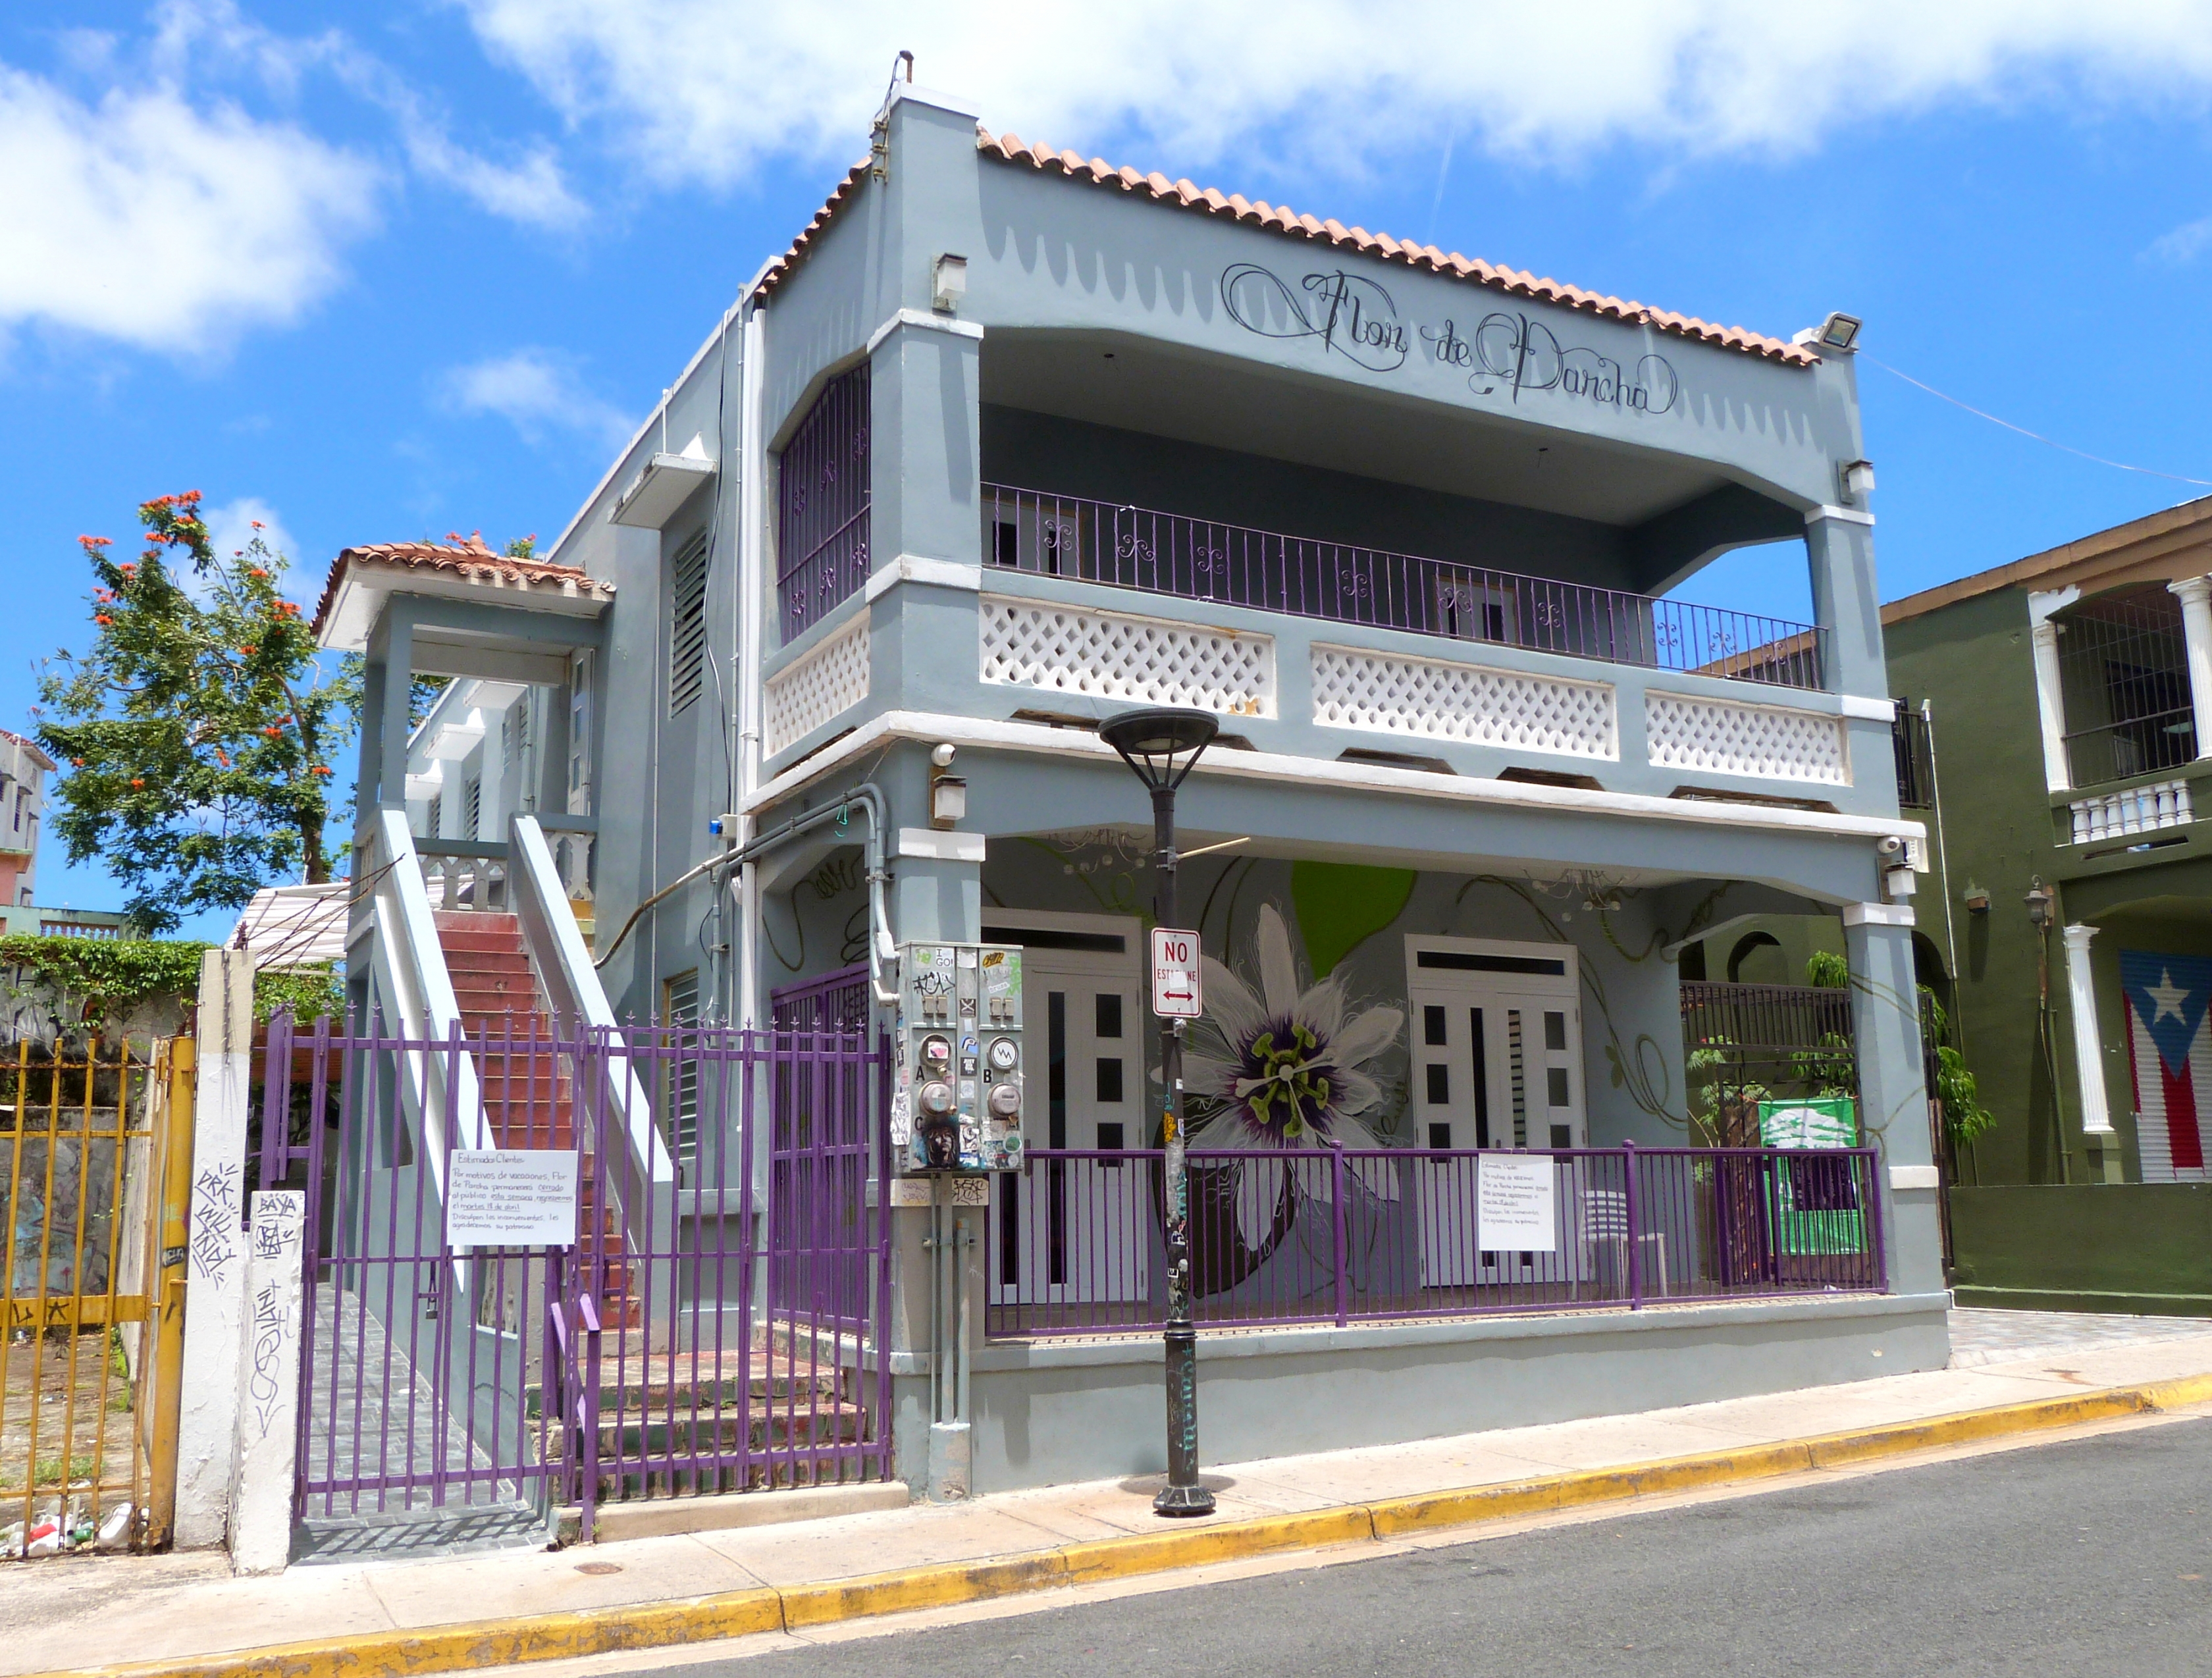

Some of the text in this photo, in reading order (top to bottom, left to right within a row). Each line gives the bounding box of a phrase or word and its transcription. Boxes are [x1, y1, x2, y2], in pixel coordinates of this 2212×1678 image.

[1421, 319, 1472, 367] de
[1468, 313, 1678, 415] Parcha
[1165, 941, 1188, 963] NO
[1157, 968, 1196, 982] ESTNE
[916, 1065, 925, 1081] A
[984, 1068, 991, 1084] B
[452, 1167, 464, 1177] Por
[498, 1170, 508, 1180] de
[463, 1180, 488, 1190] Parcha
[452, 1213, 484, 1222] Disculpen
